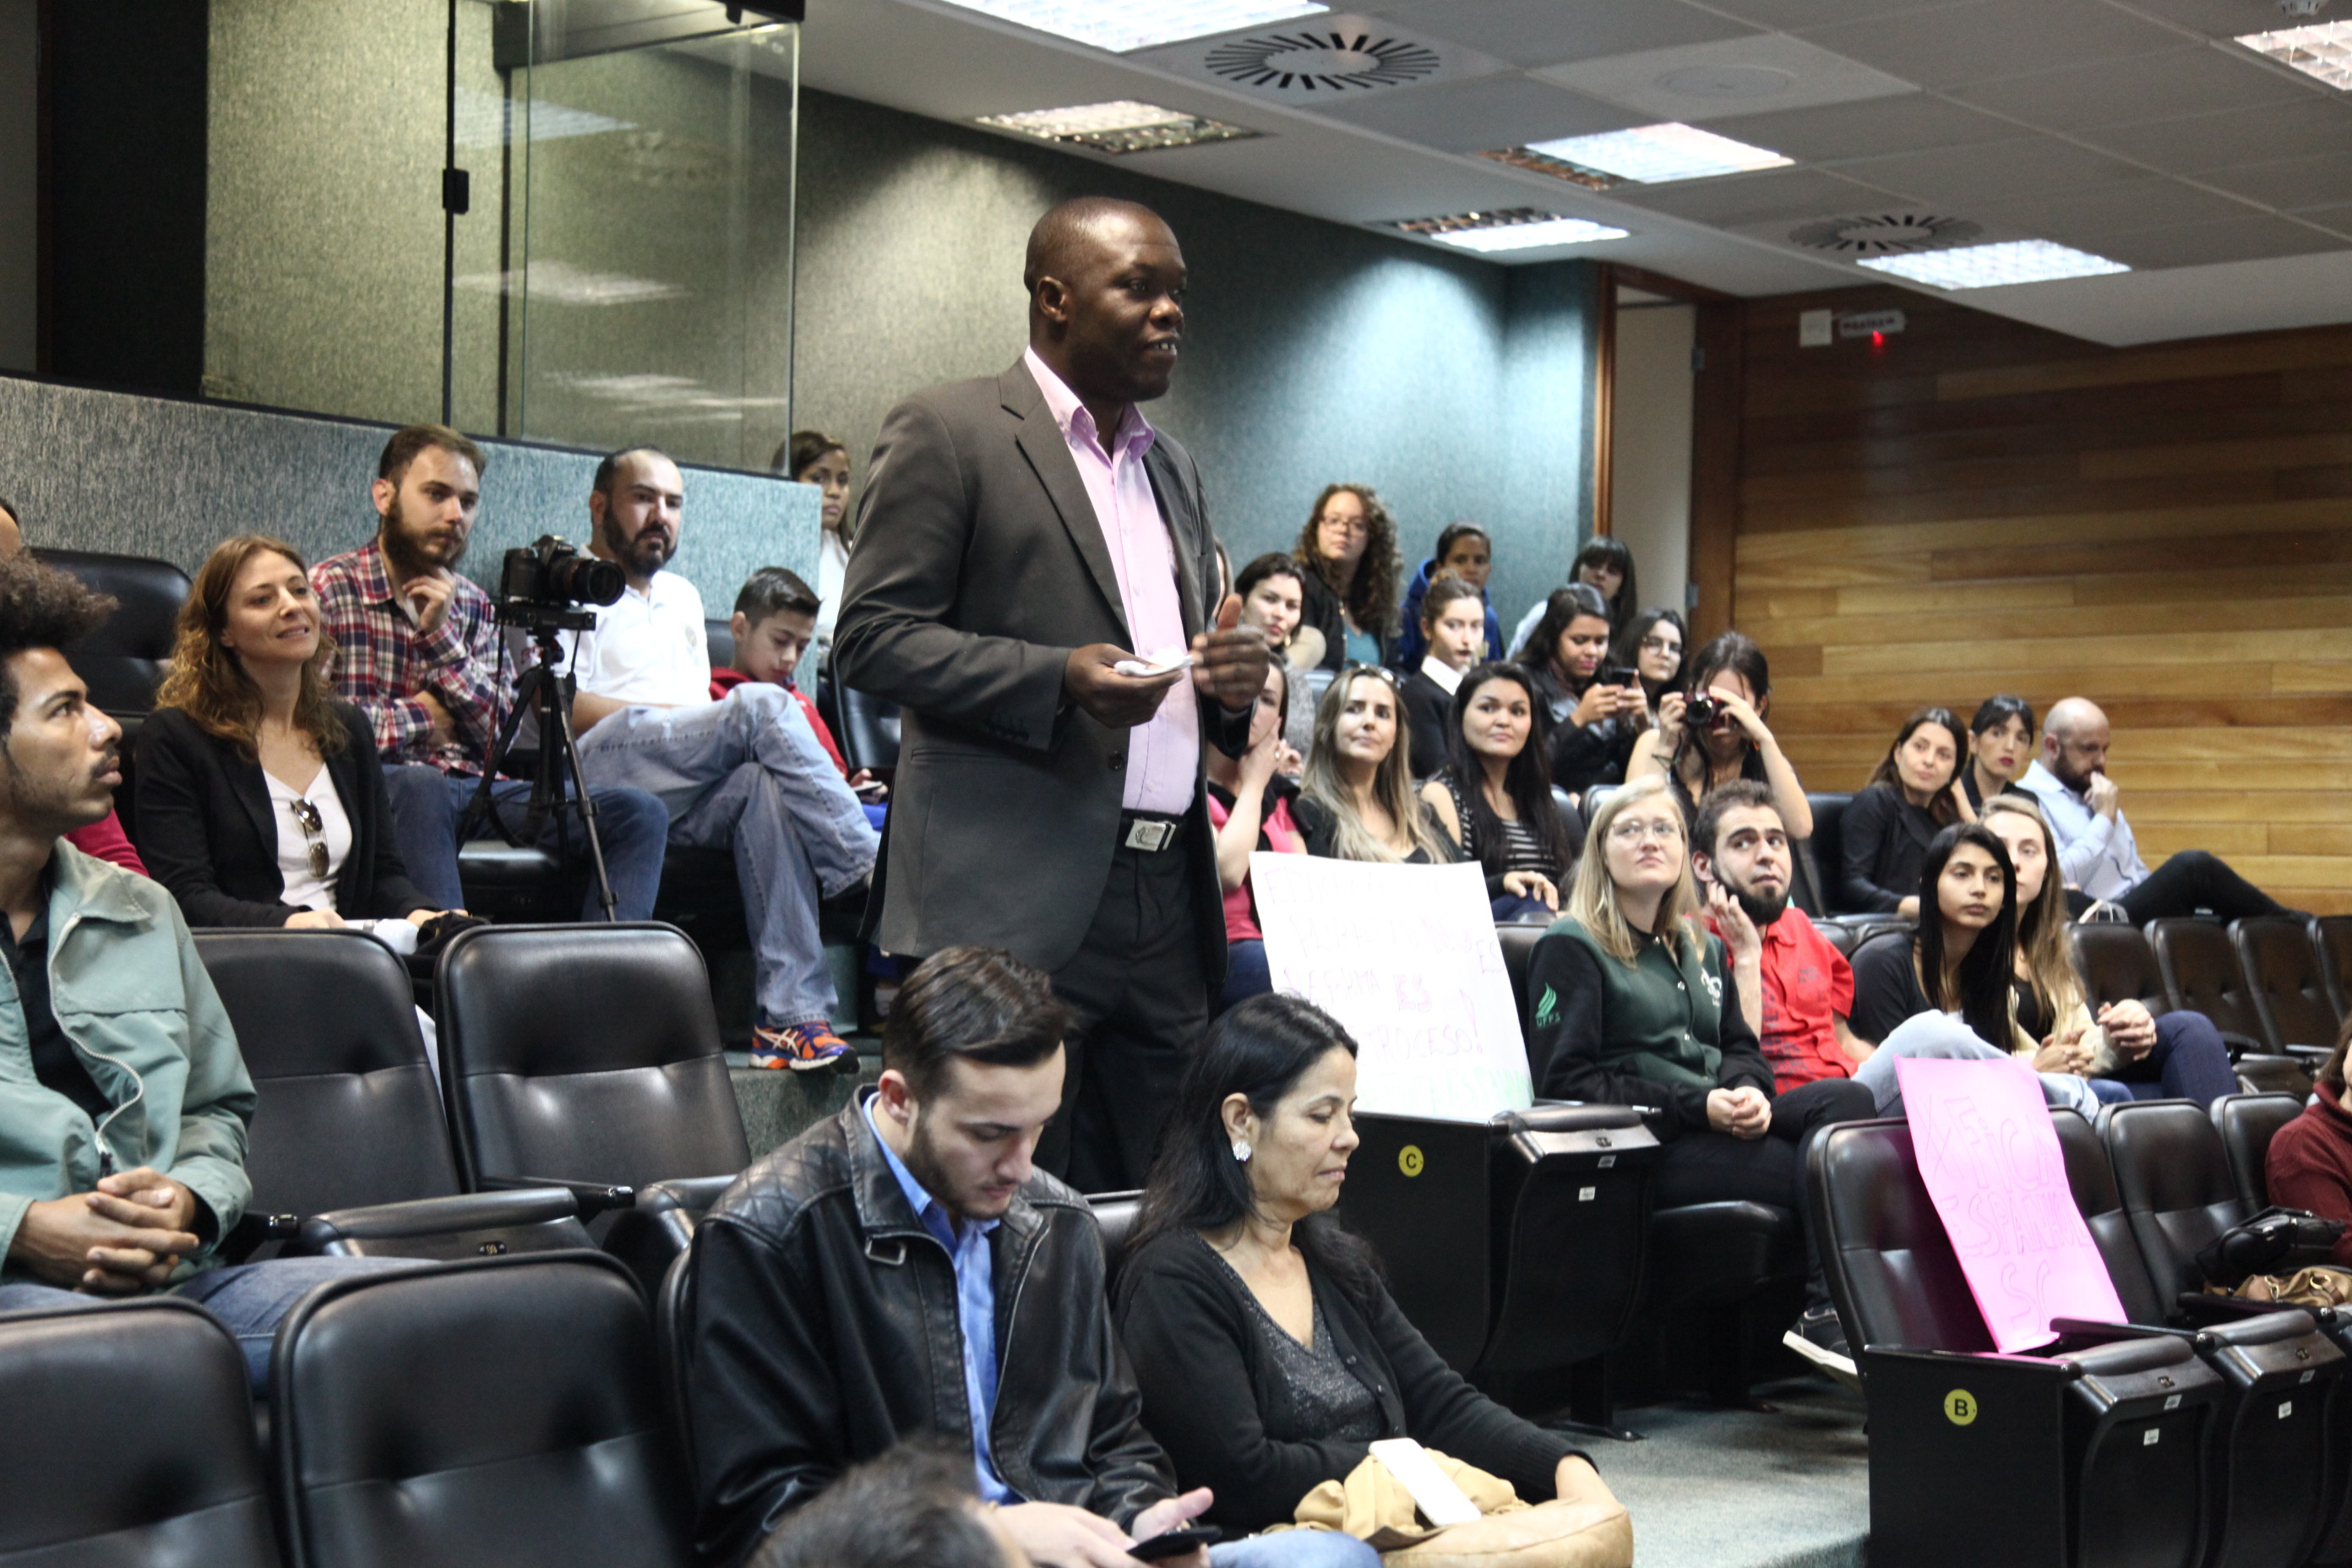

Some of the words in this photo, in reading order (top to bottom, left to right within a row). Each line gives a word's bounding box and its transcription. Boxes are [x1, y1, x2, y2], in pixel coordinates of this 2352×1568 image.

[1393, 972, 1433, 1014] ES
[1406, 1152, 1417, 1169] C
[1954, 1398, 1968, 1417] B
